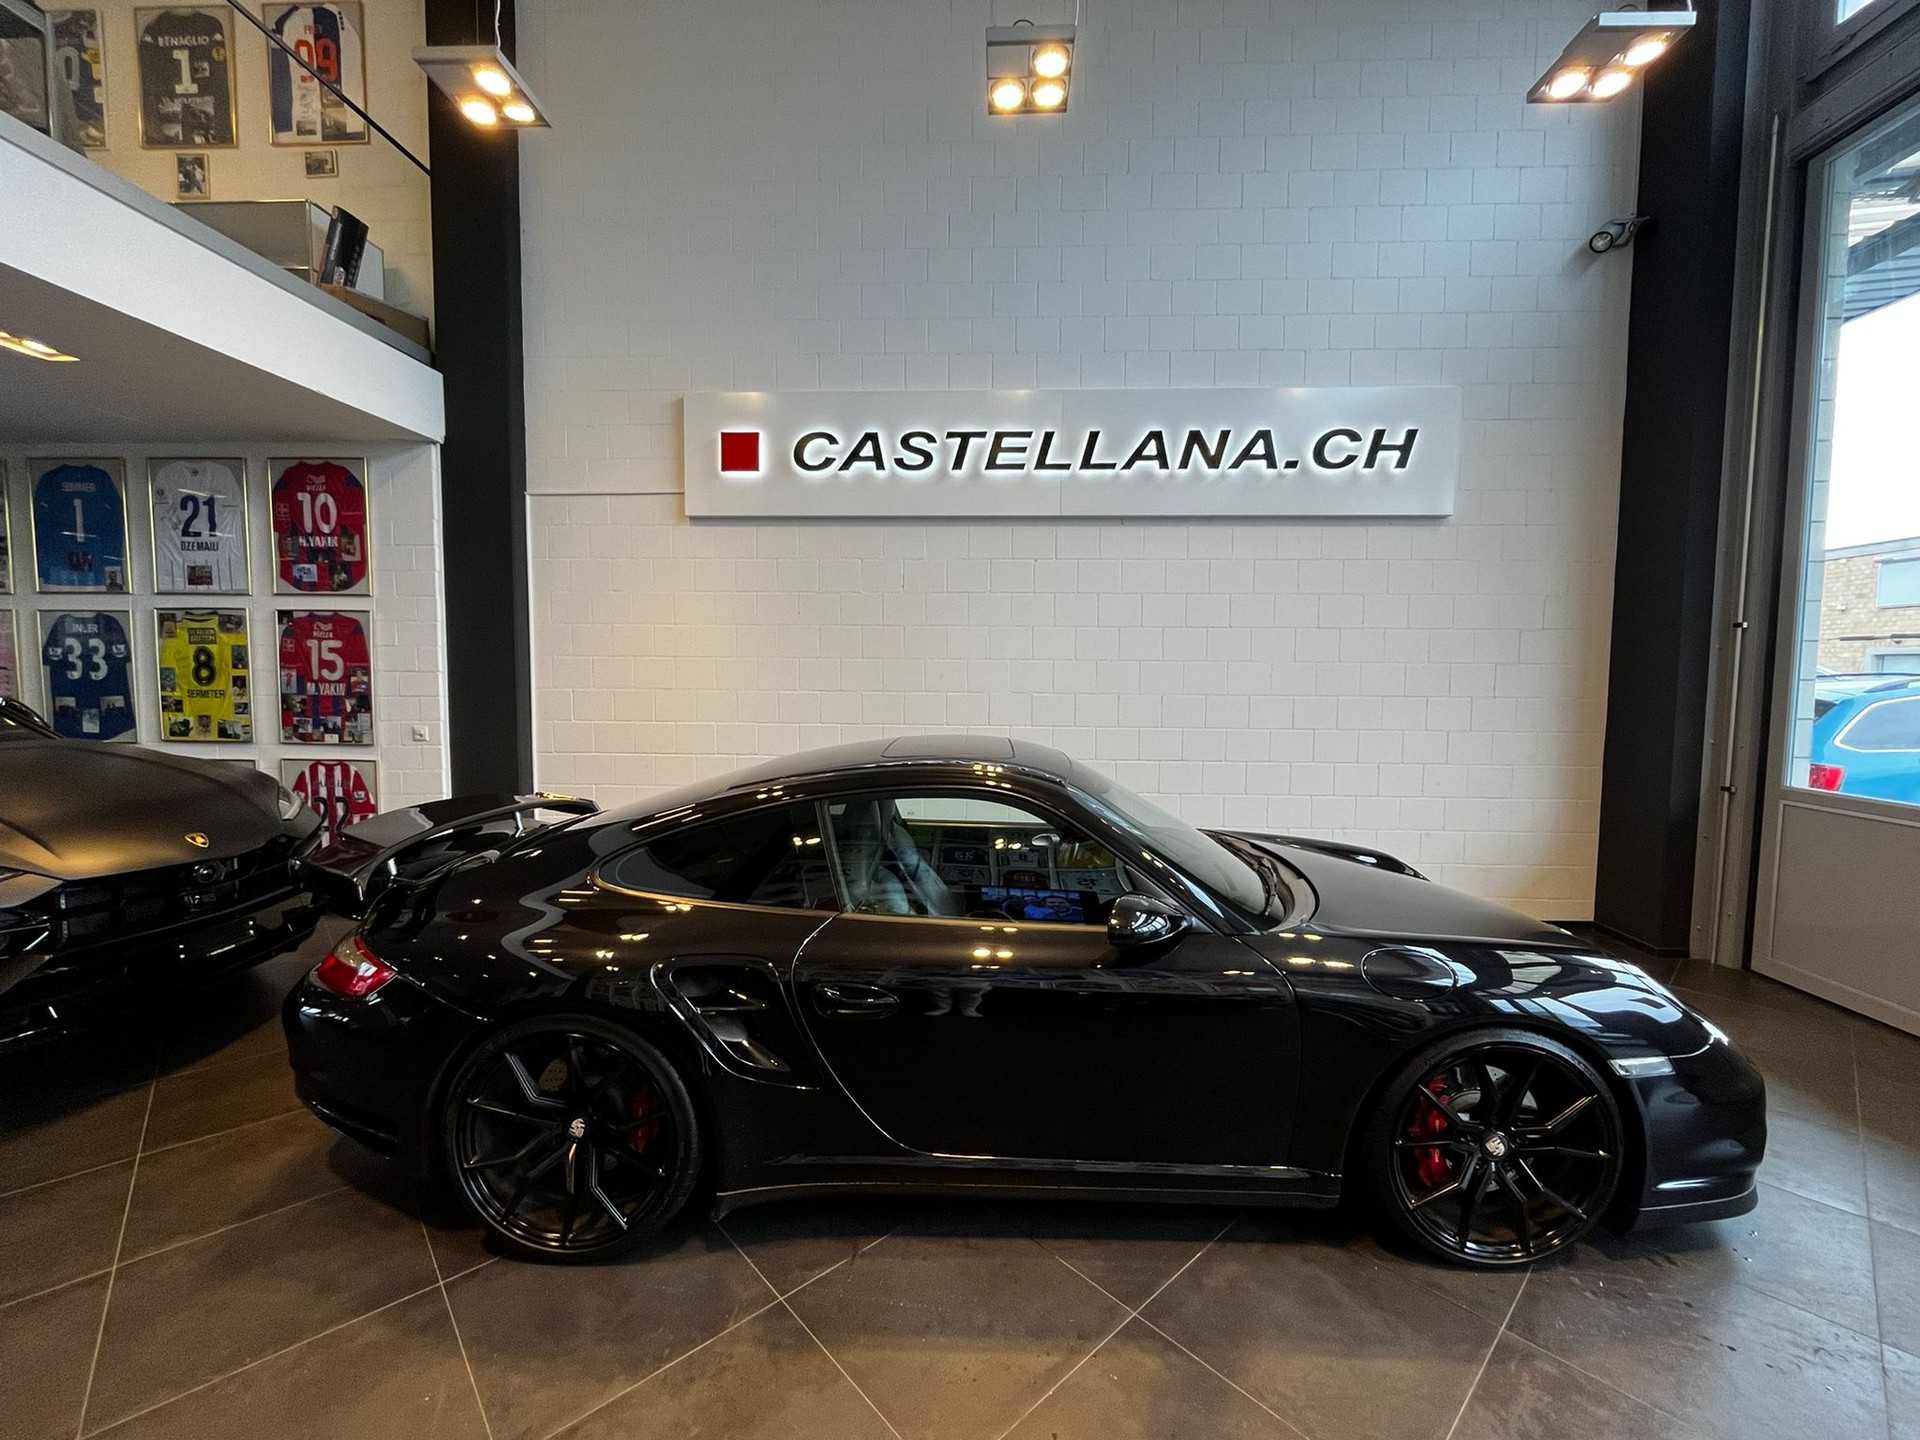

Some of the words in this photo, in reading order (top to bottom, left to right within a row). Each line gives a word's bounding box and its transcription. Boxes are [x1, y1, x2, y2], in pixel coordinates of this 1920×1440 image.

[157, 35, 209, 47] BENAGLIO
[173, 49, 198, 94] 1
[793, 428, 1418, 471] CASTELLANA.CH
[73, 498, 84, 542] 1
[180, 495, 217, 537] 21
[297, 492, 337, 534] 10
[181, 541, 219, 551] DZEMAILI
[65, 637, 108, 680] 33
[192, 646, 216, 687] 8
[306, 639, 344, 681] 15
